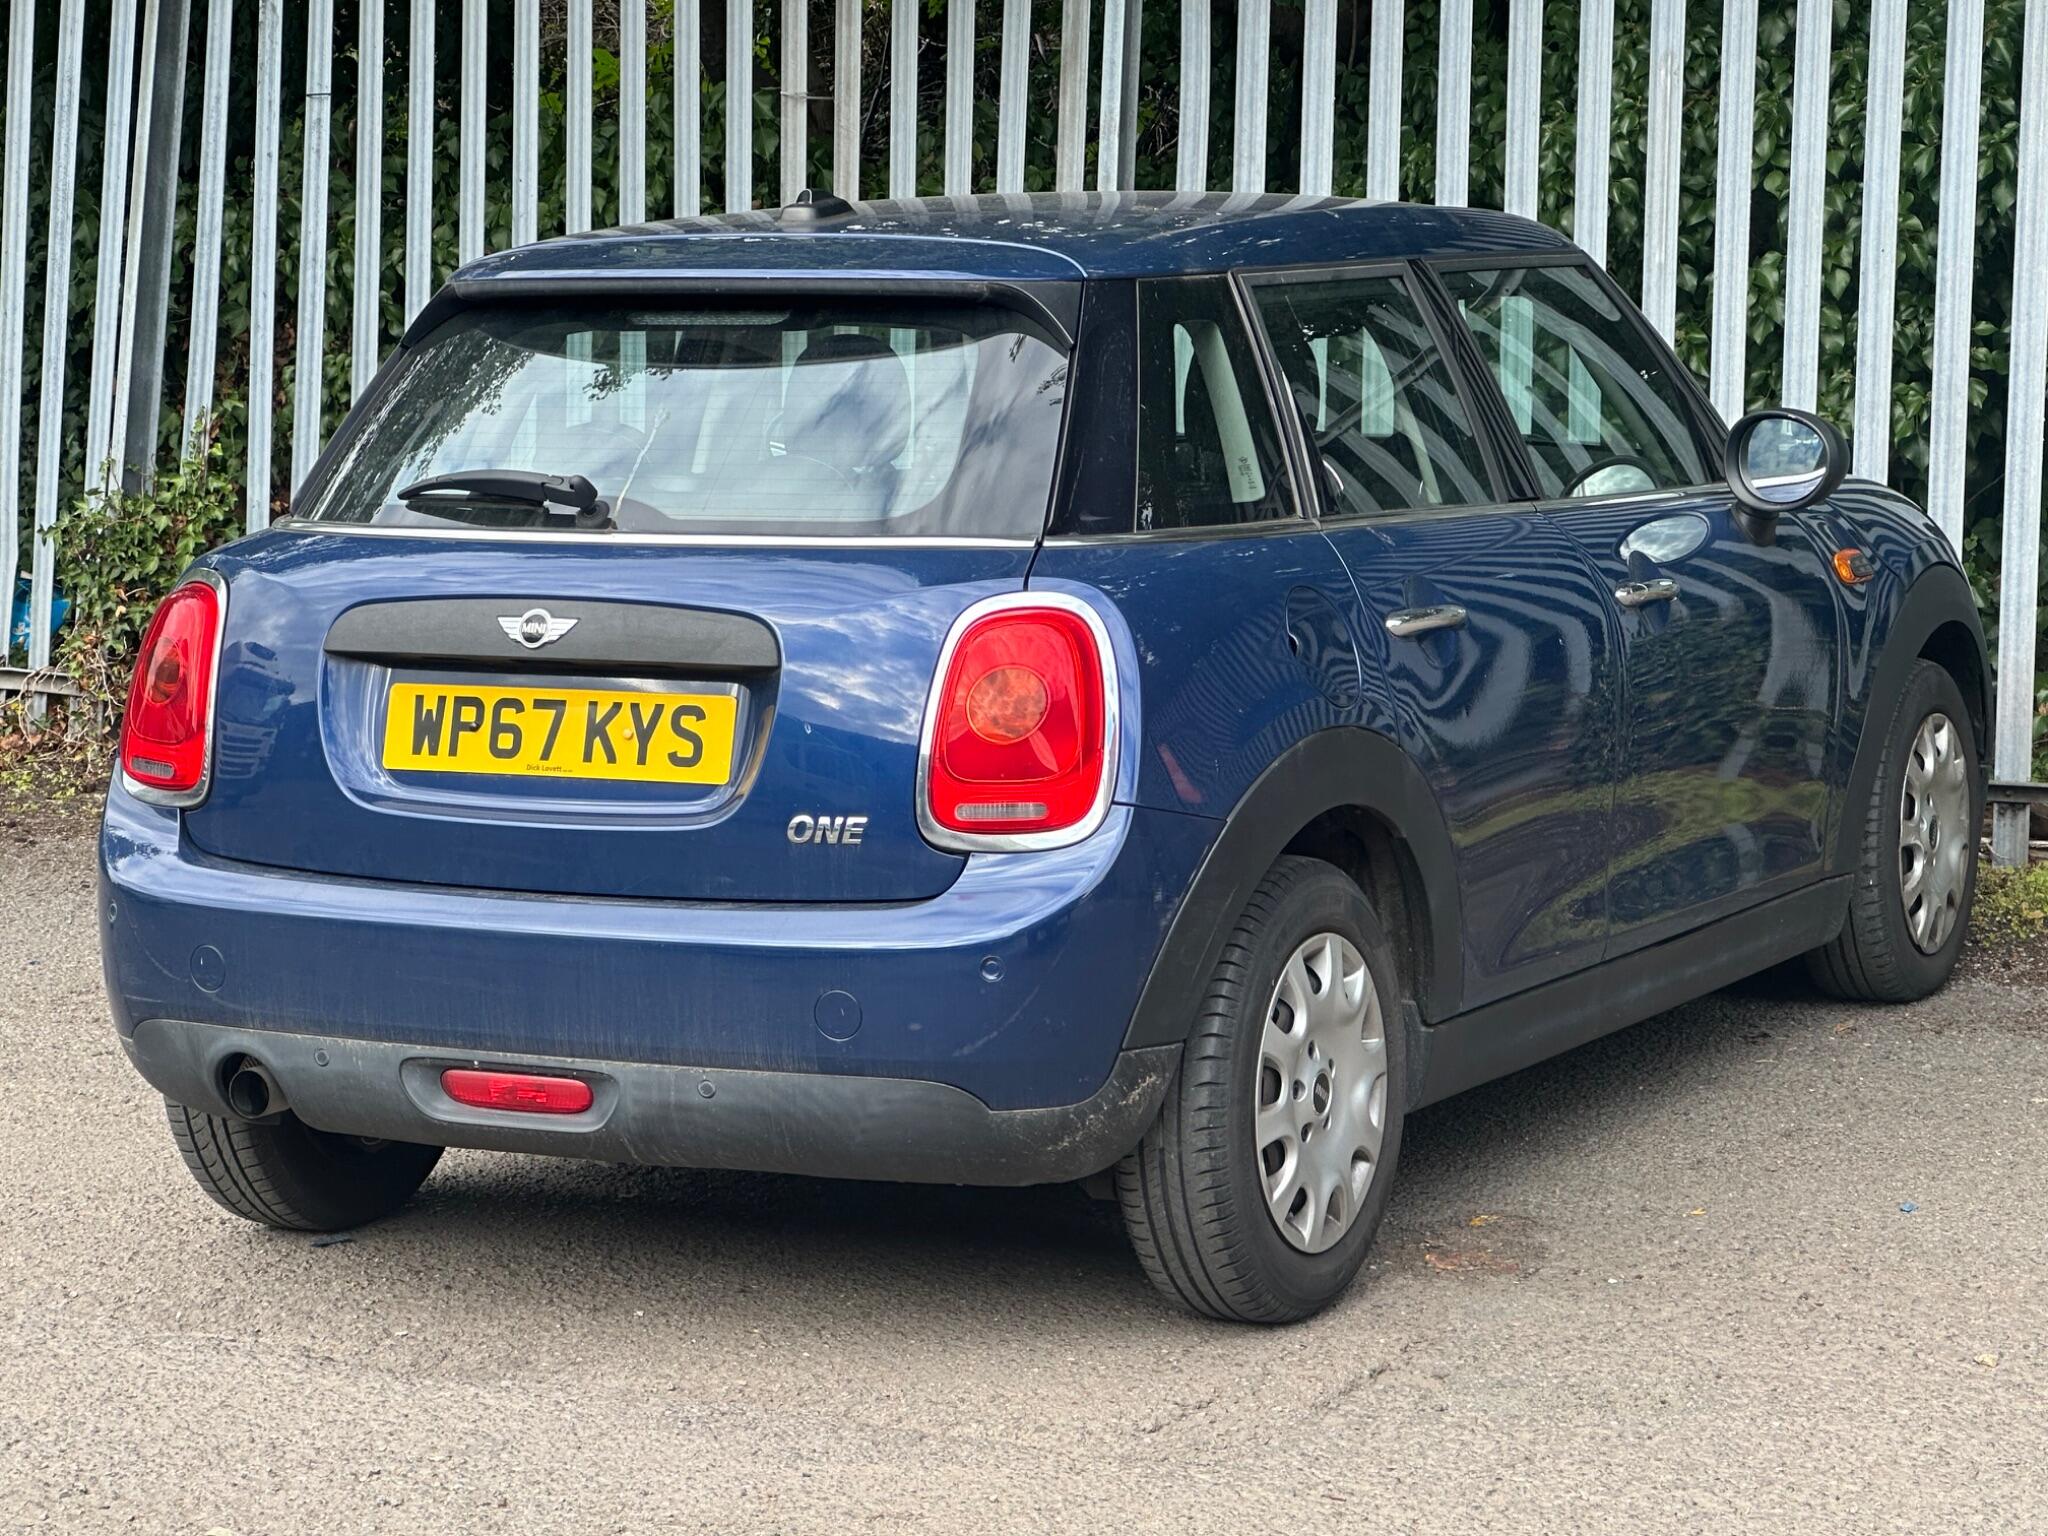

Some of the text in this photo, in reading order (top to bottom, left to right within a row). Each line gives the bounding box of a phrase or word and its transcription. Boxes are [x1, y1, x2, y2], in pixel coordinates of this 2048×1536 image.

[521, 622, 547, 634] MINI
[412, 694, 706, 767] WP67 KYS
[541, 765, 562, 773] Lovett
[787, 814, 868, 844] ONE
